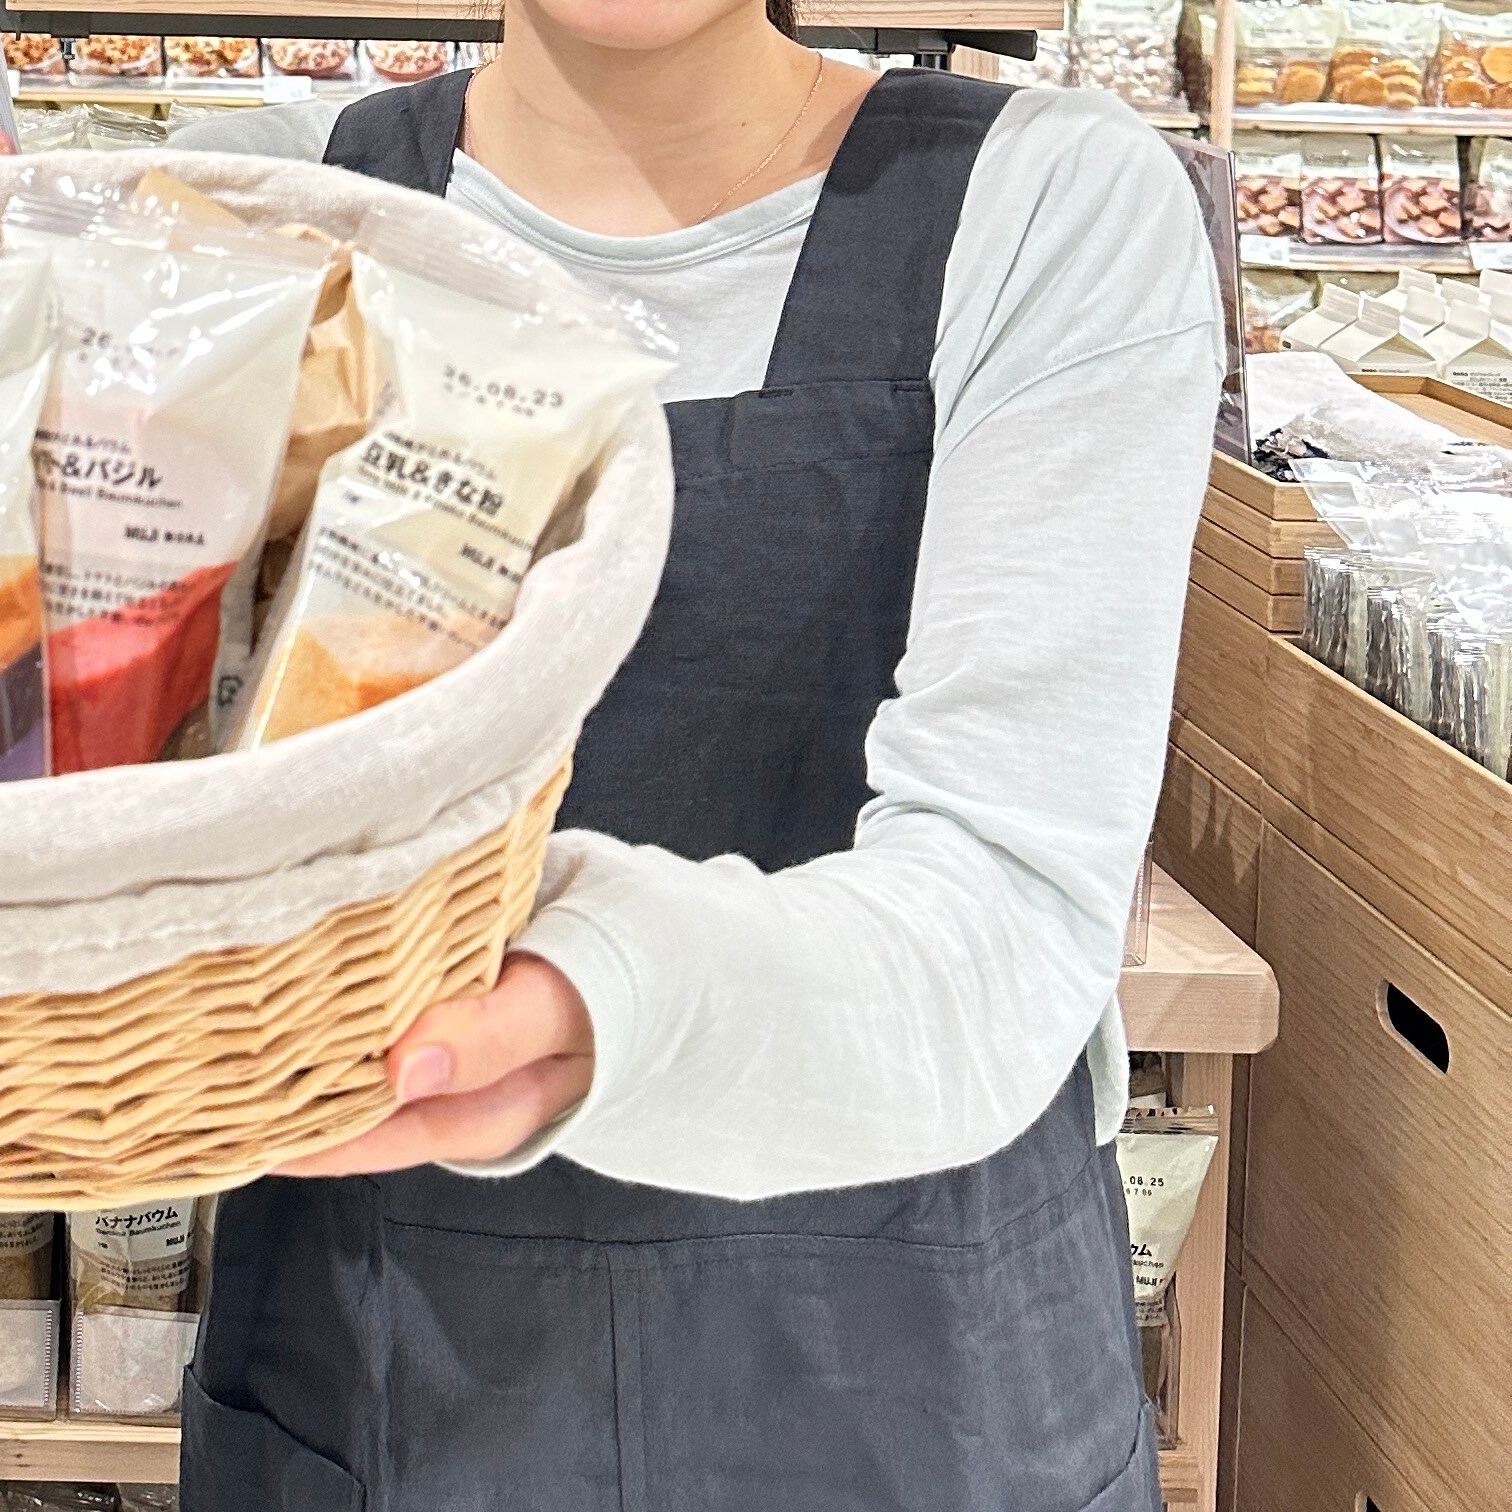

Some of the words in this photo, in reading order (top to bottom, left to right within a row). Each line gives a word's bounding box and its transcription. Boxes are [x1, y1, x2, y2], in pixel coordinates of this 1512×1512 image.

[361, 441, 503, 516] 豆乳&きな粉
[124, 524, 159, 543] MUJI
[95, 1206, 178, 1229] バナナバウム
[166, 1234, 185, 1247] MUJI
[1136, 1275, 1157, 1286] MUJI
